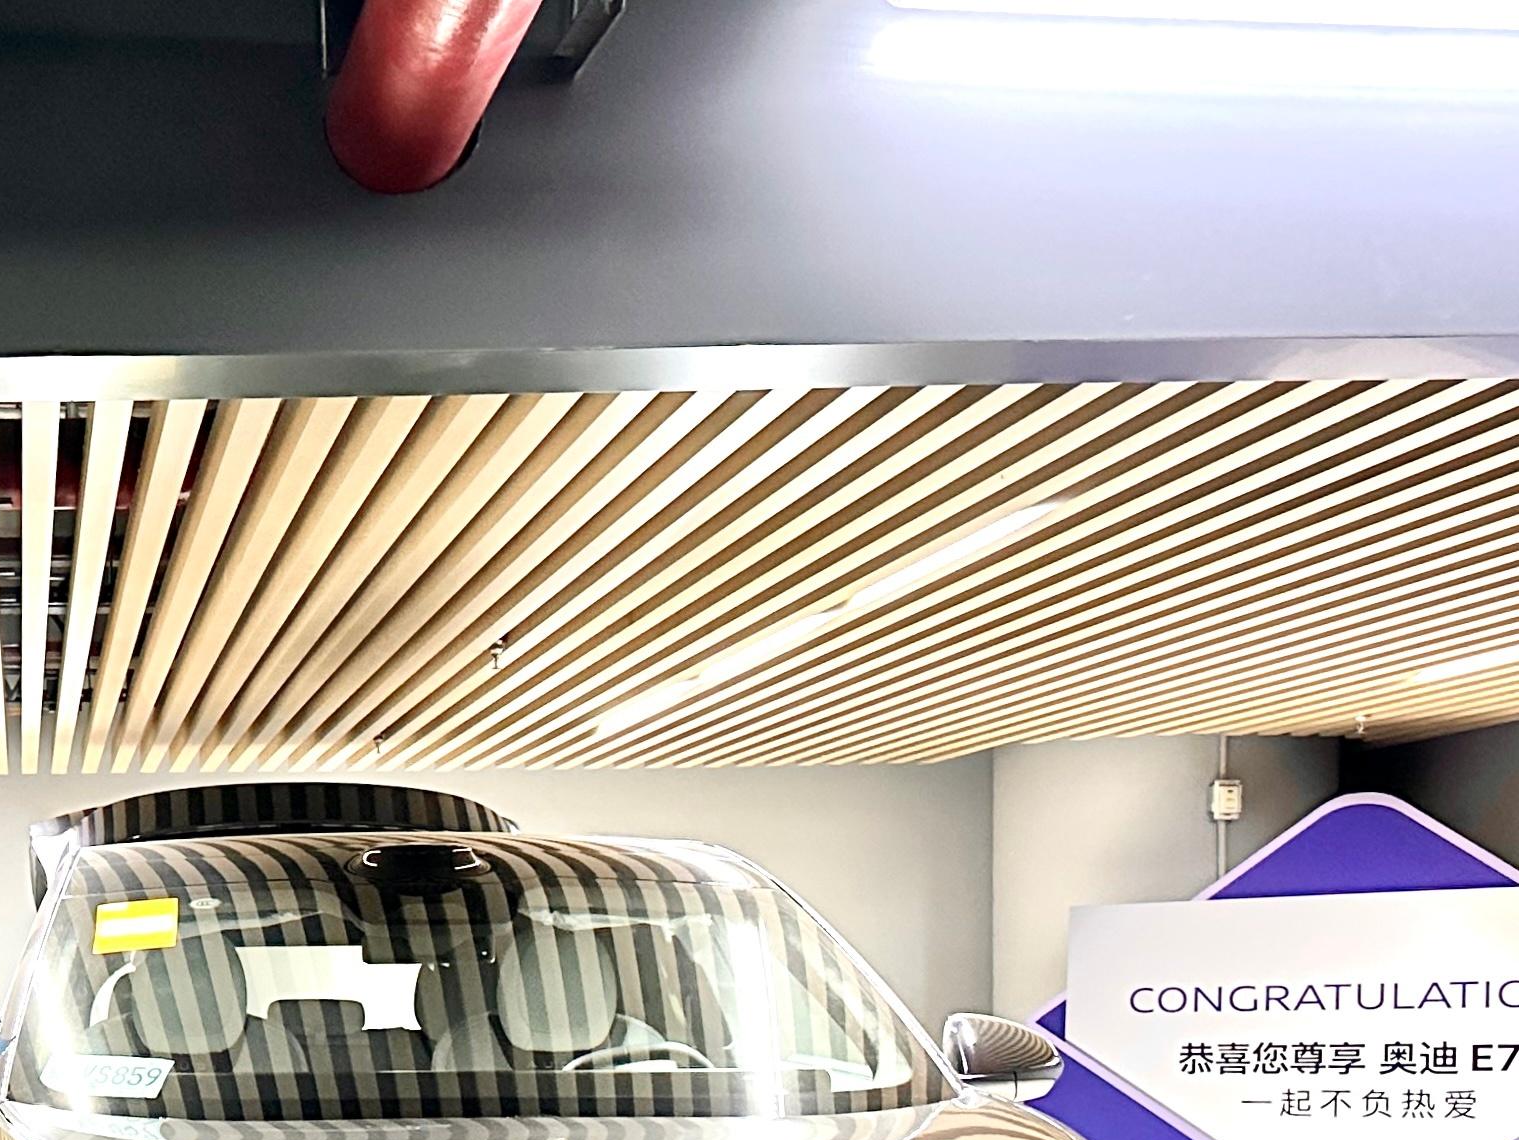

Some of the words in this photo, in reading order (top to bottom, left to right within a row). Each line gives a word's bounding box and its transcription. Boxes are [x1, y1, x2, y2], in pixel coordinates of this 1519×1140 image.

[1178, 1041, 1366, 1076] 恭喜您尊享
[1379, 1041, 1459, 1076] 奥迪
[1471, 1044, 1519, 1072] E7
[1241, 1088, 1477, 1120] 一起不负热爱
